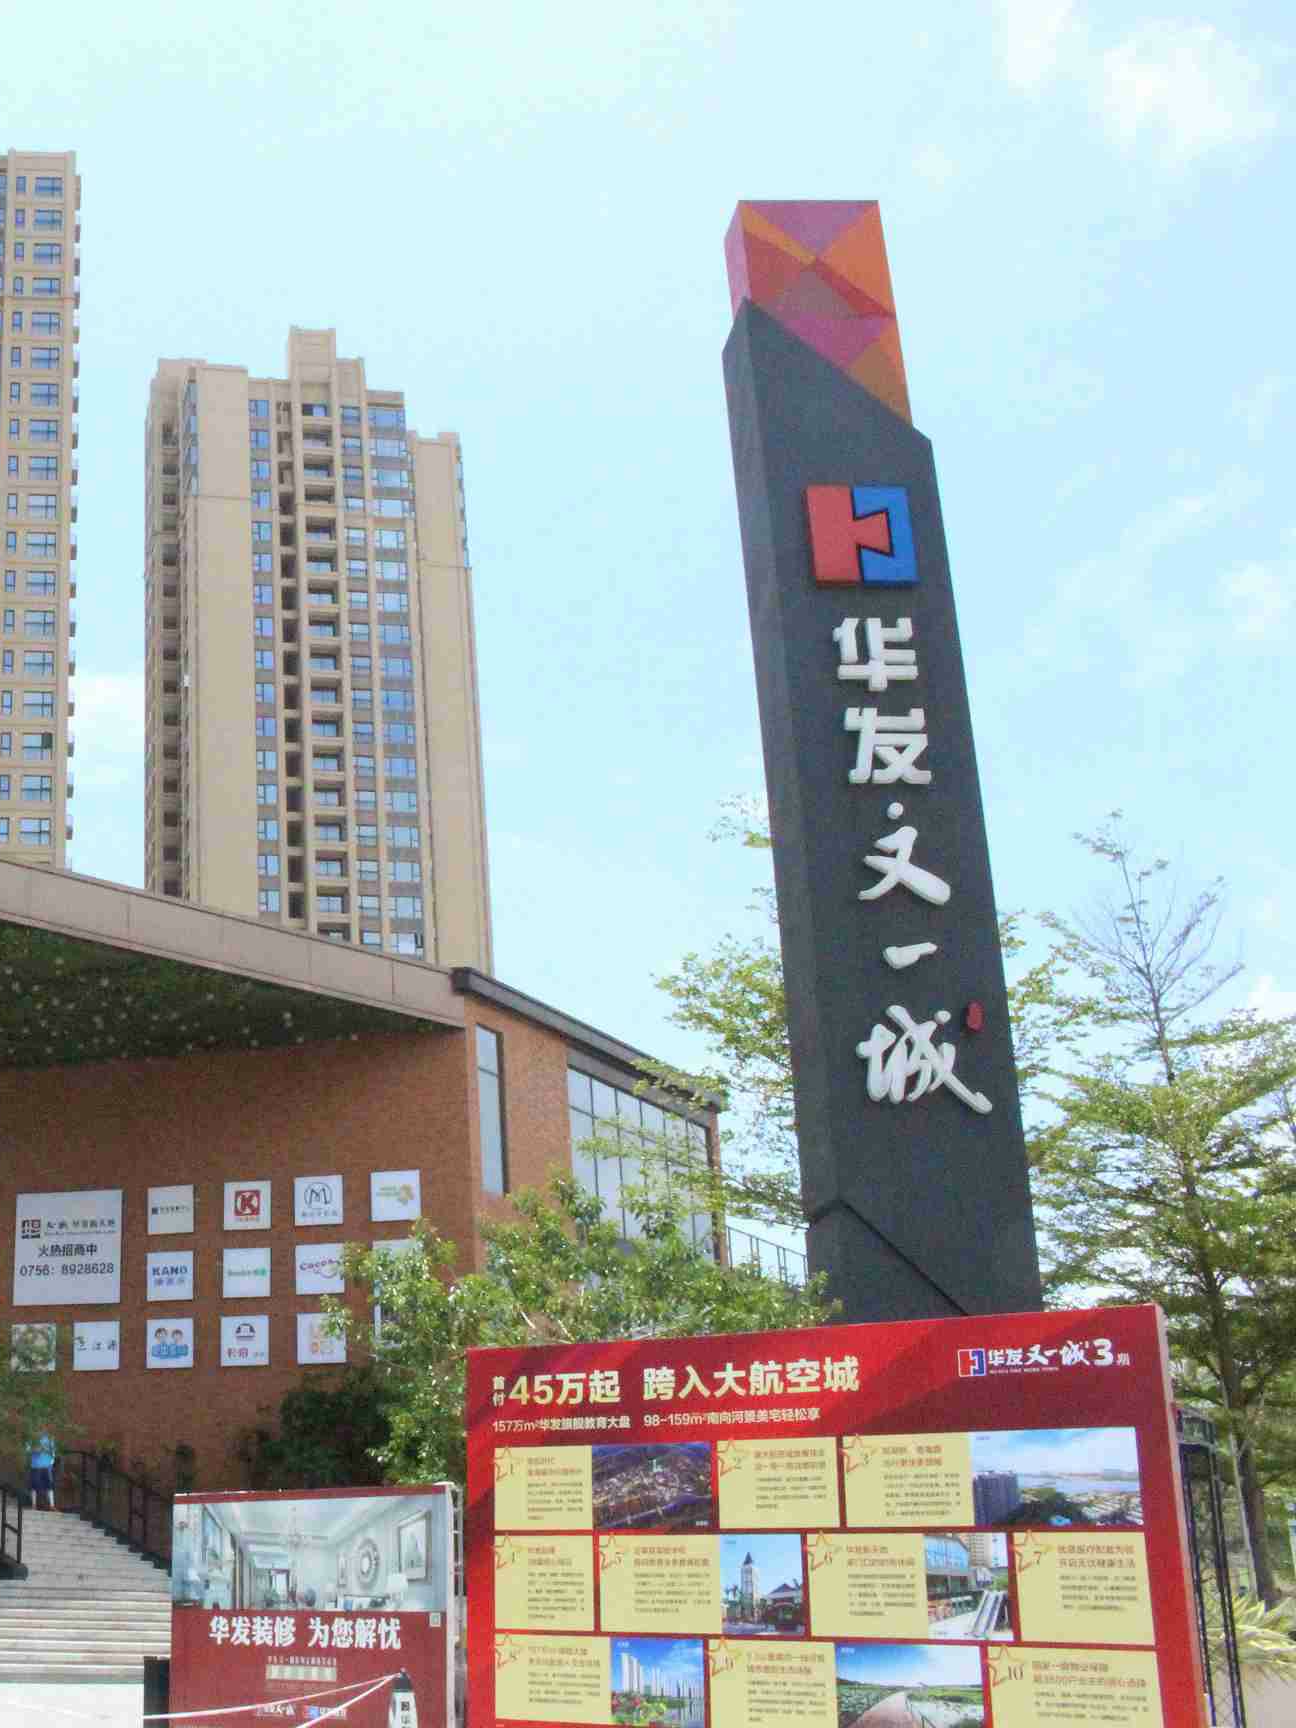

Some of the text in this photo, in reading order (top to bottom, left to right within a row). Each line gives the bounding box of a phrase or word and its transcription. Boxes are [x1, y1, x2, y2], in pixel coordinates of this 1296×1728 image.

[38, 1244, 97, 1258] 火热招商中
[508, 1368, 622, 1406] 45万起
[642, 1355, 861, 1401] 跨入大航空城
[208, 1616, 402, 1650] 华发装修 为您解忧
